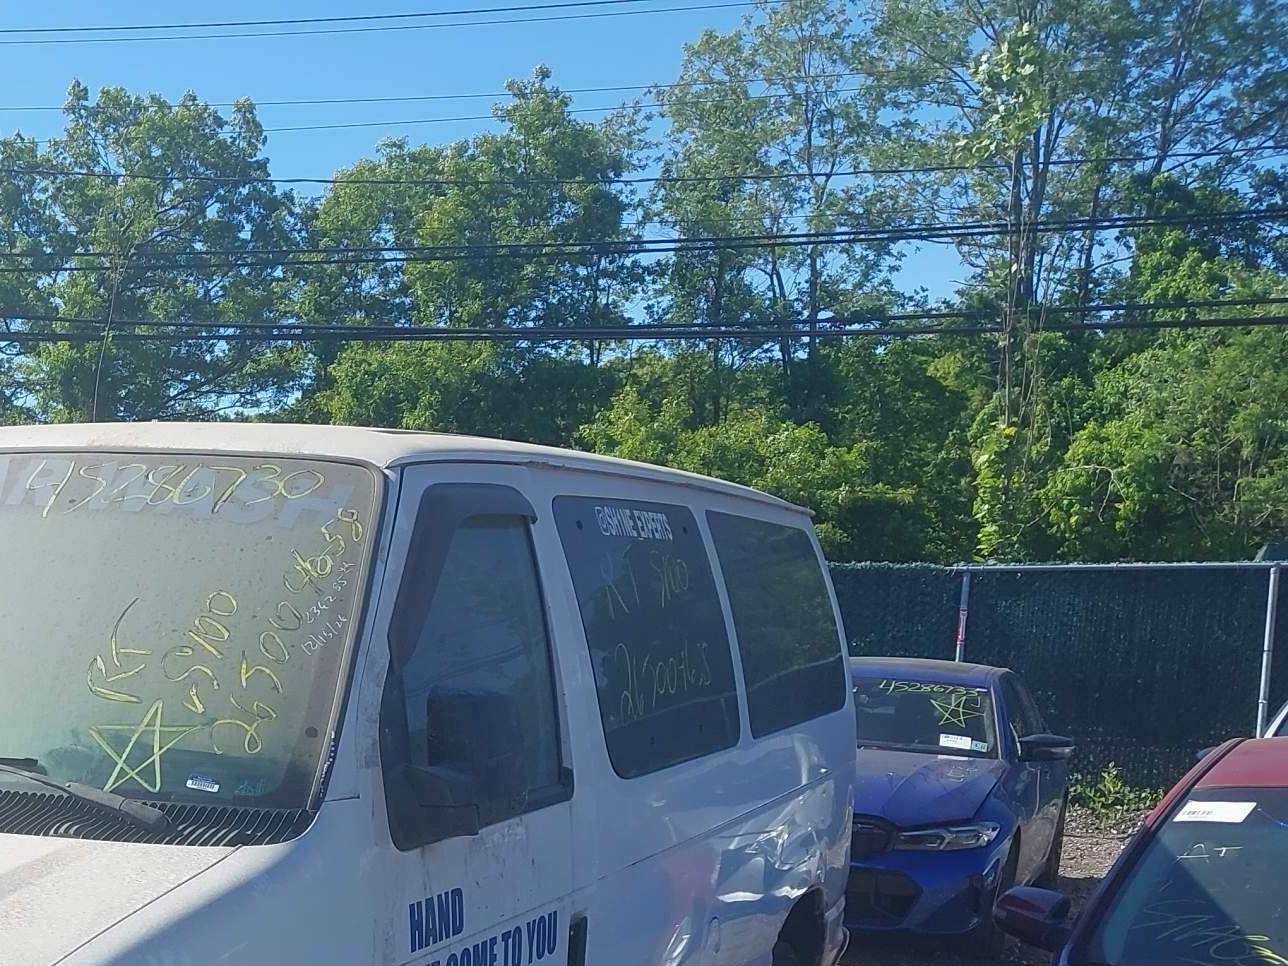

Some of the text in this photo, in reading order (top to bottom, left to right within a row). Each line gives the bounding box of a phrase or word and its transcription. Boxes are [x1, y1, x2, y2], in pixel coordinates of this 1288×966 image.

[26, 460, 325, 518] 45286730
[409, 887, 464, 954] HAND
[526, 910, 559, 965] YOU
